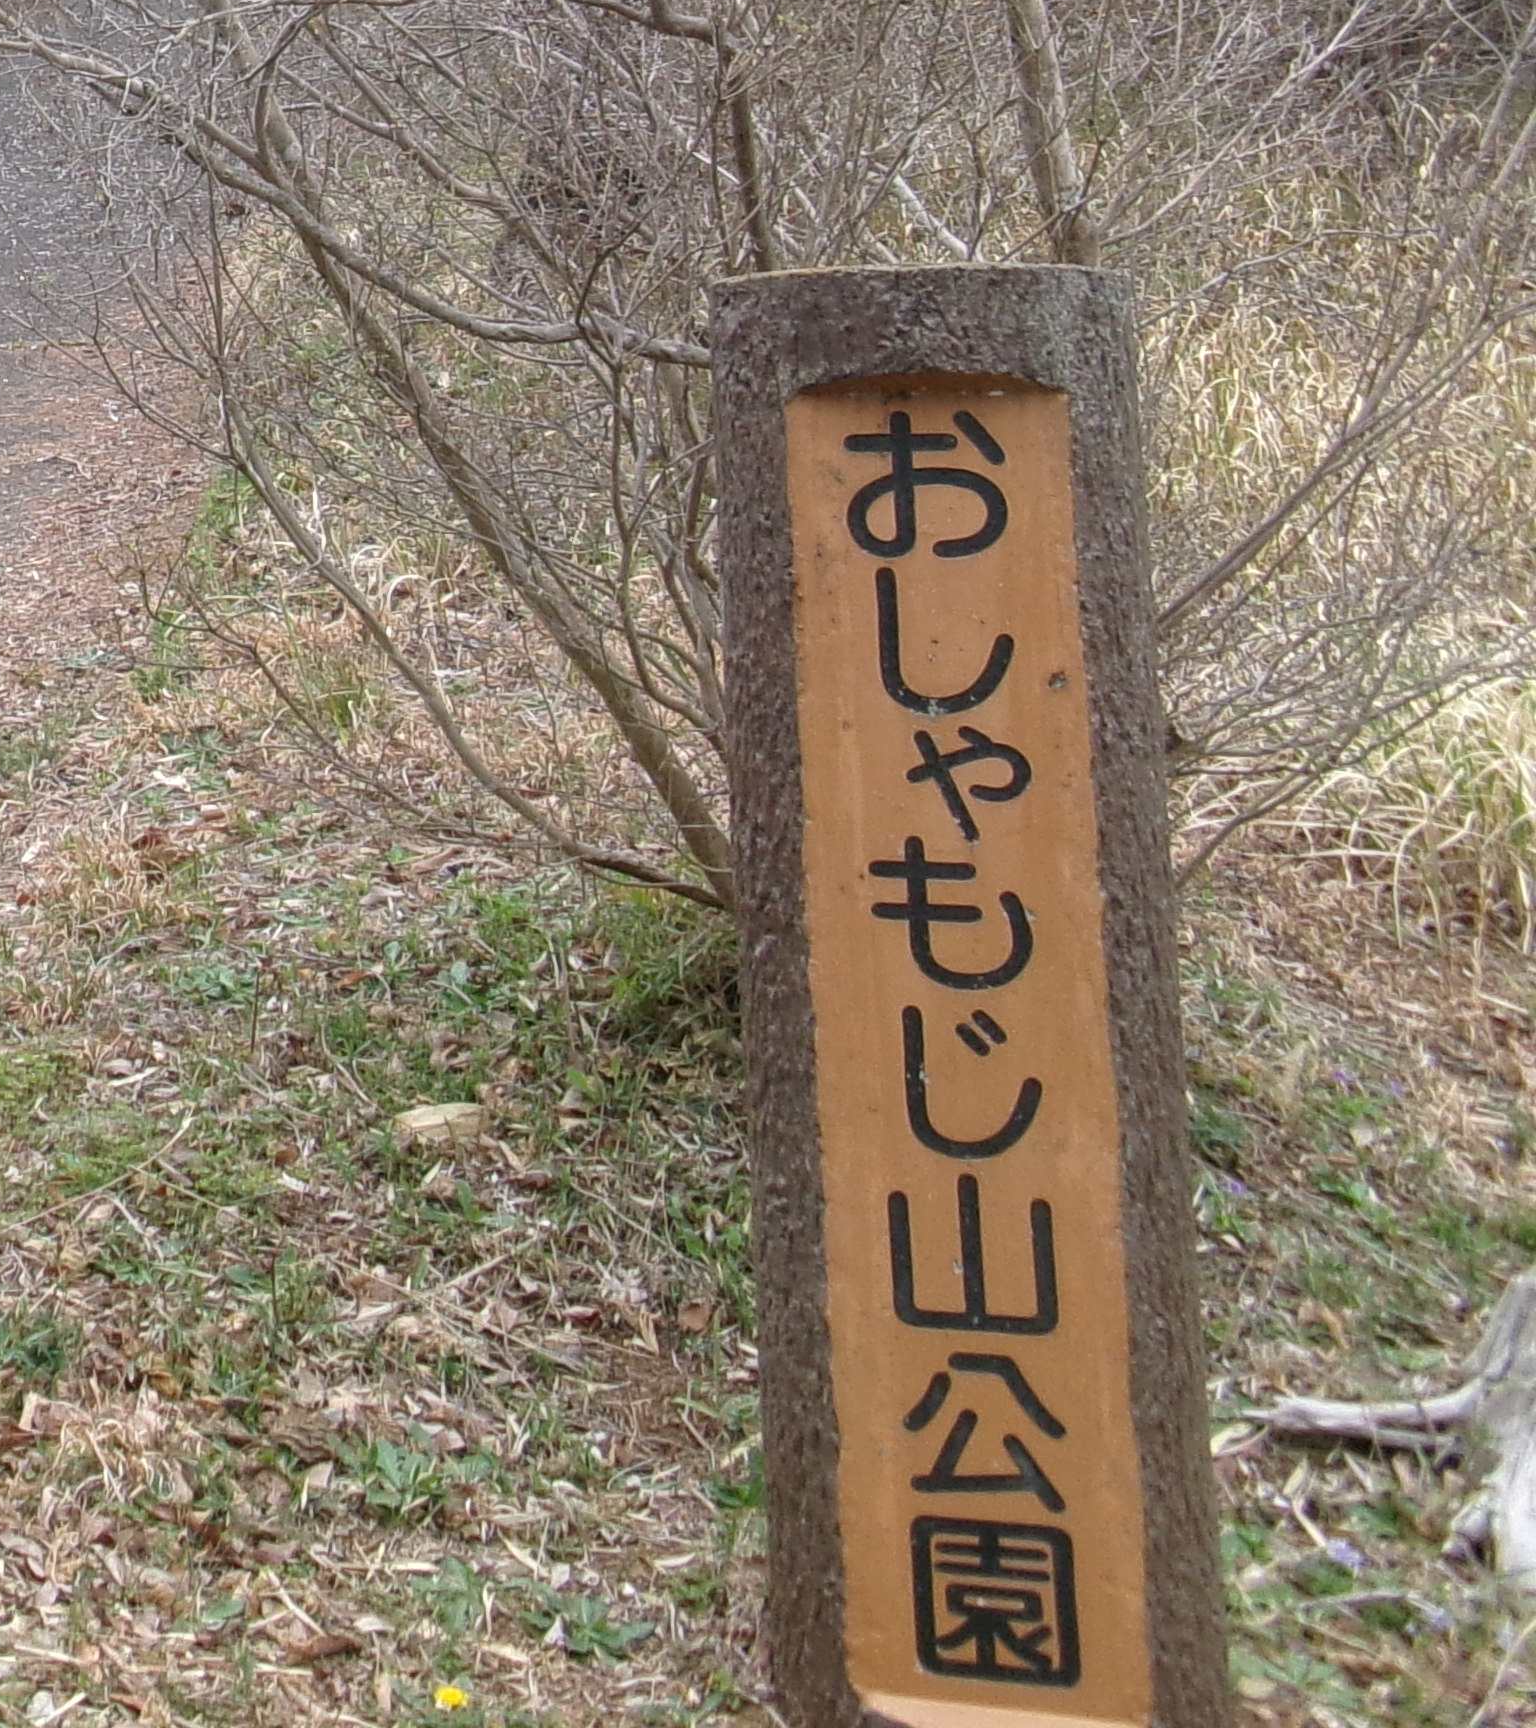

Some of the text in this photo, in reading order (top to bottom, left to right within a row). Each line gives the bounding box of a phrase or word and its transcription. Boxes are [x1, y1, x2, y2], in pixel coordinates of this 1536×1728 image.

[844, 411, 1081, 1689] おしゃもじ山公園
